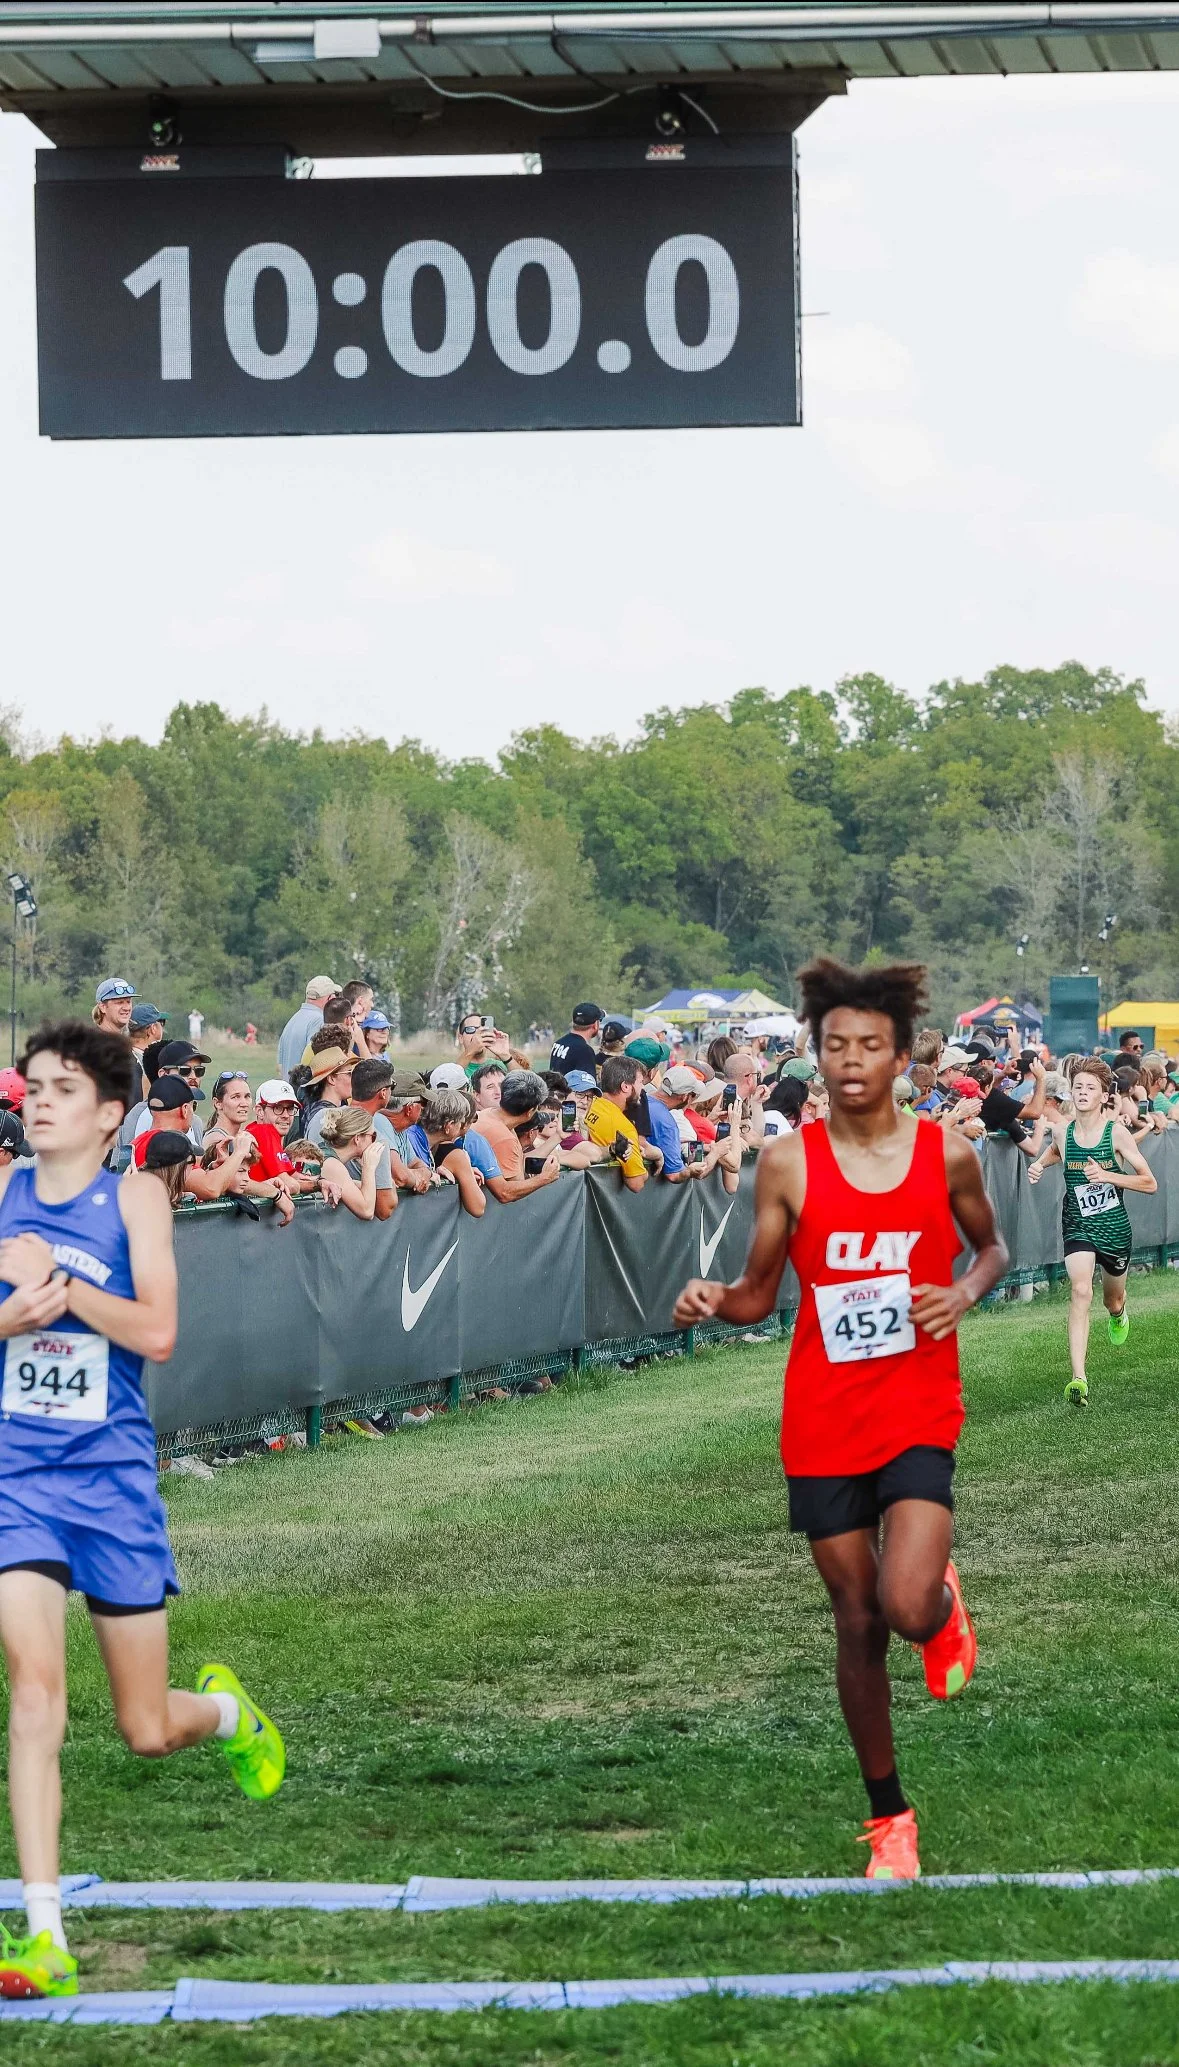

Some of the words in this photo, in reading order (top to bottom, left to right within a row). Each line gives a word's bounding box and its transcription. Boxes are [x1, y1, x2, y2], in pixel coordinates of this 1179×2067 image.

[123, 234, 740, 381] 10:00.0
[584, 1112, 600, 1125] CH
[1080, 1188, 1116, 1210] 1074
[51, 1243, 113, 1287] ASTERN
[825, 1231, 922, 1272] CLAY
[842, 1288, 881, 1304] STATE
[835, 1307, 902, 1341] 452
[32, 1340, 75, 1356] STATE
[19, 1362, 91, 1398] 944
